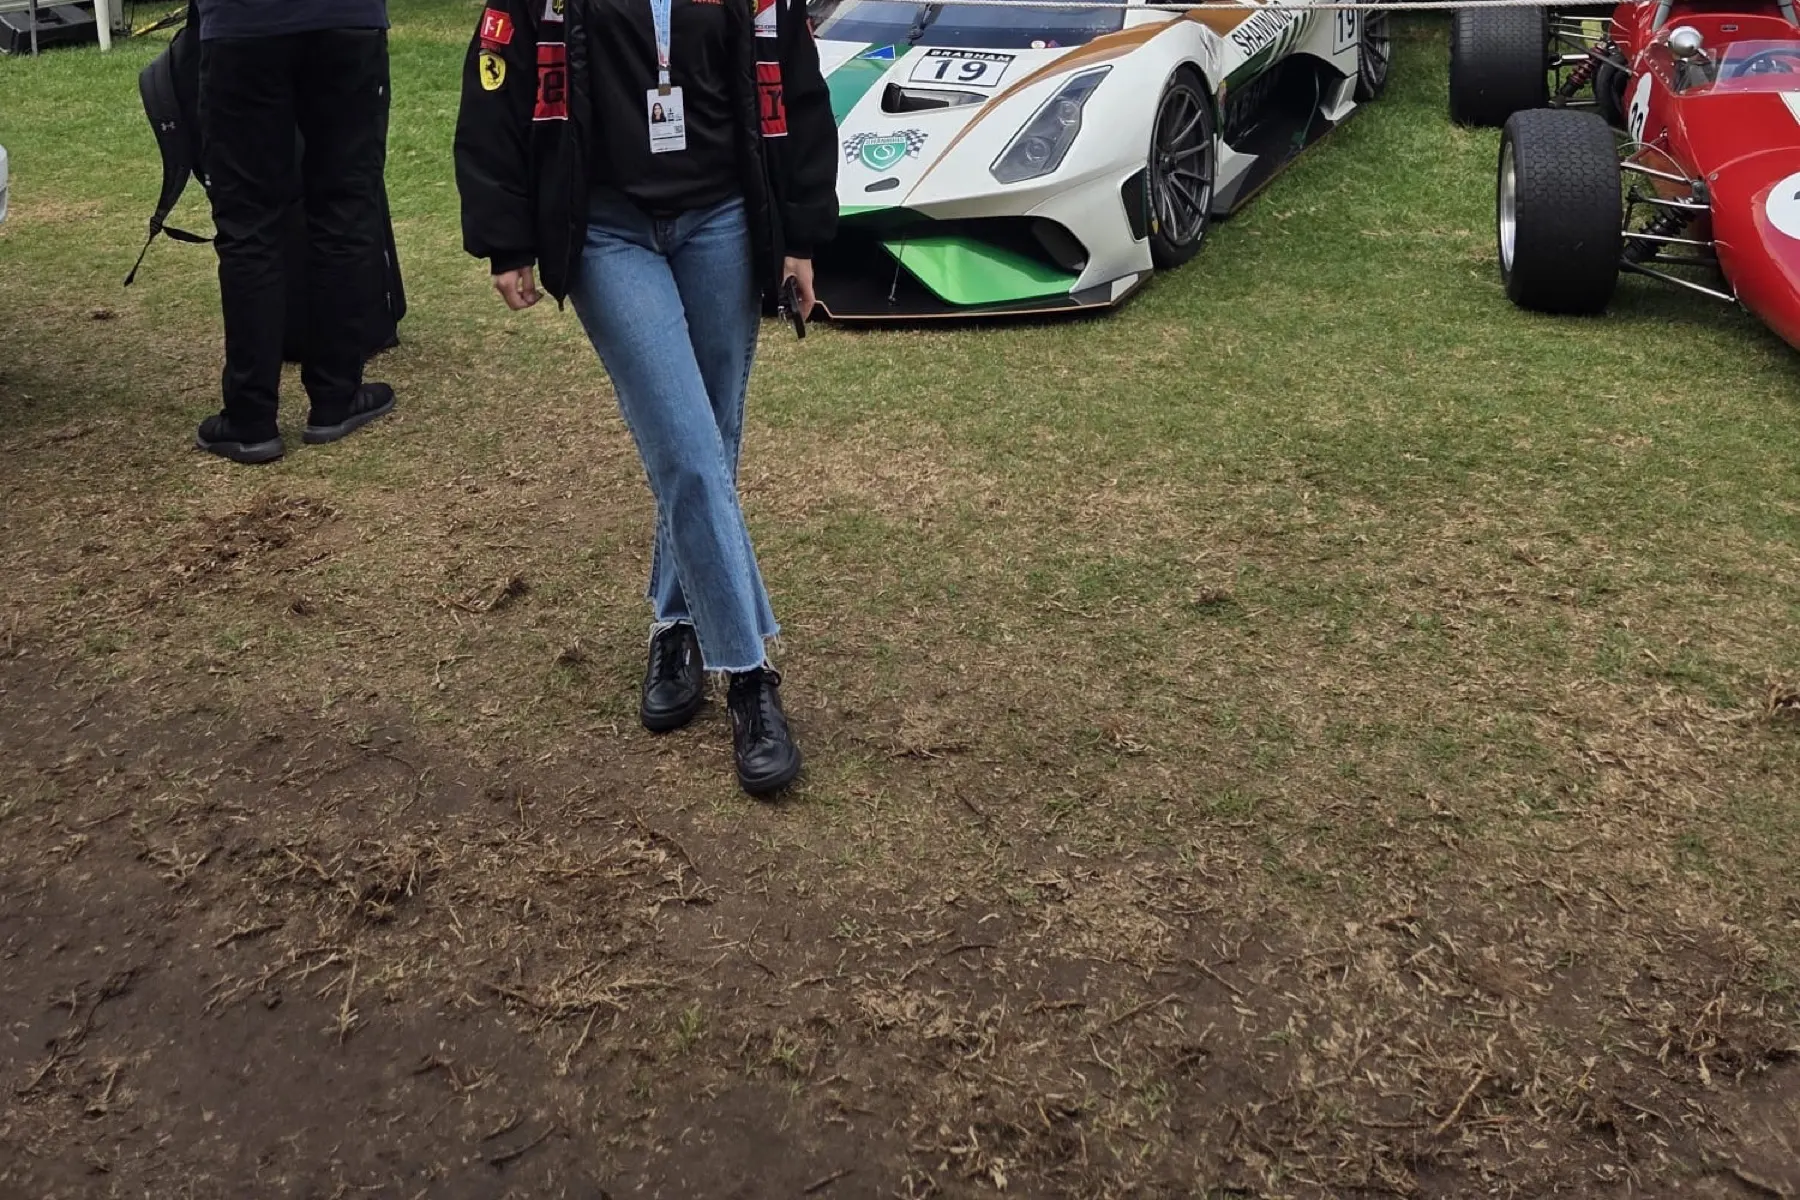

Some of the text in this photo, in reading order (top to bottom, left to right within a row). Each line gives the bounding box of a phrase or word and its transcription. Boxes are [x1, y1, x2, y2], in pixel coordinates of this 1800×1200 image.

[1231, 0, 1293, 56] SHANNONS
[1338, 7, 1355, 43] 19
[930, 49, 1011, 62] BRABHAM
[934, 59, 989, 82] 19
